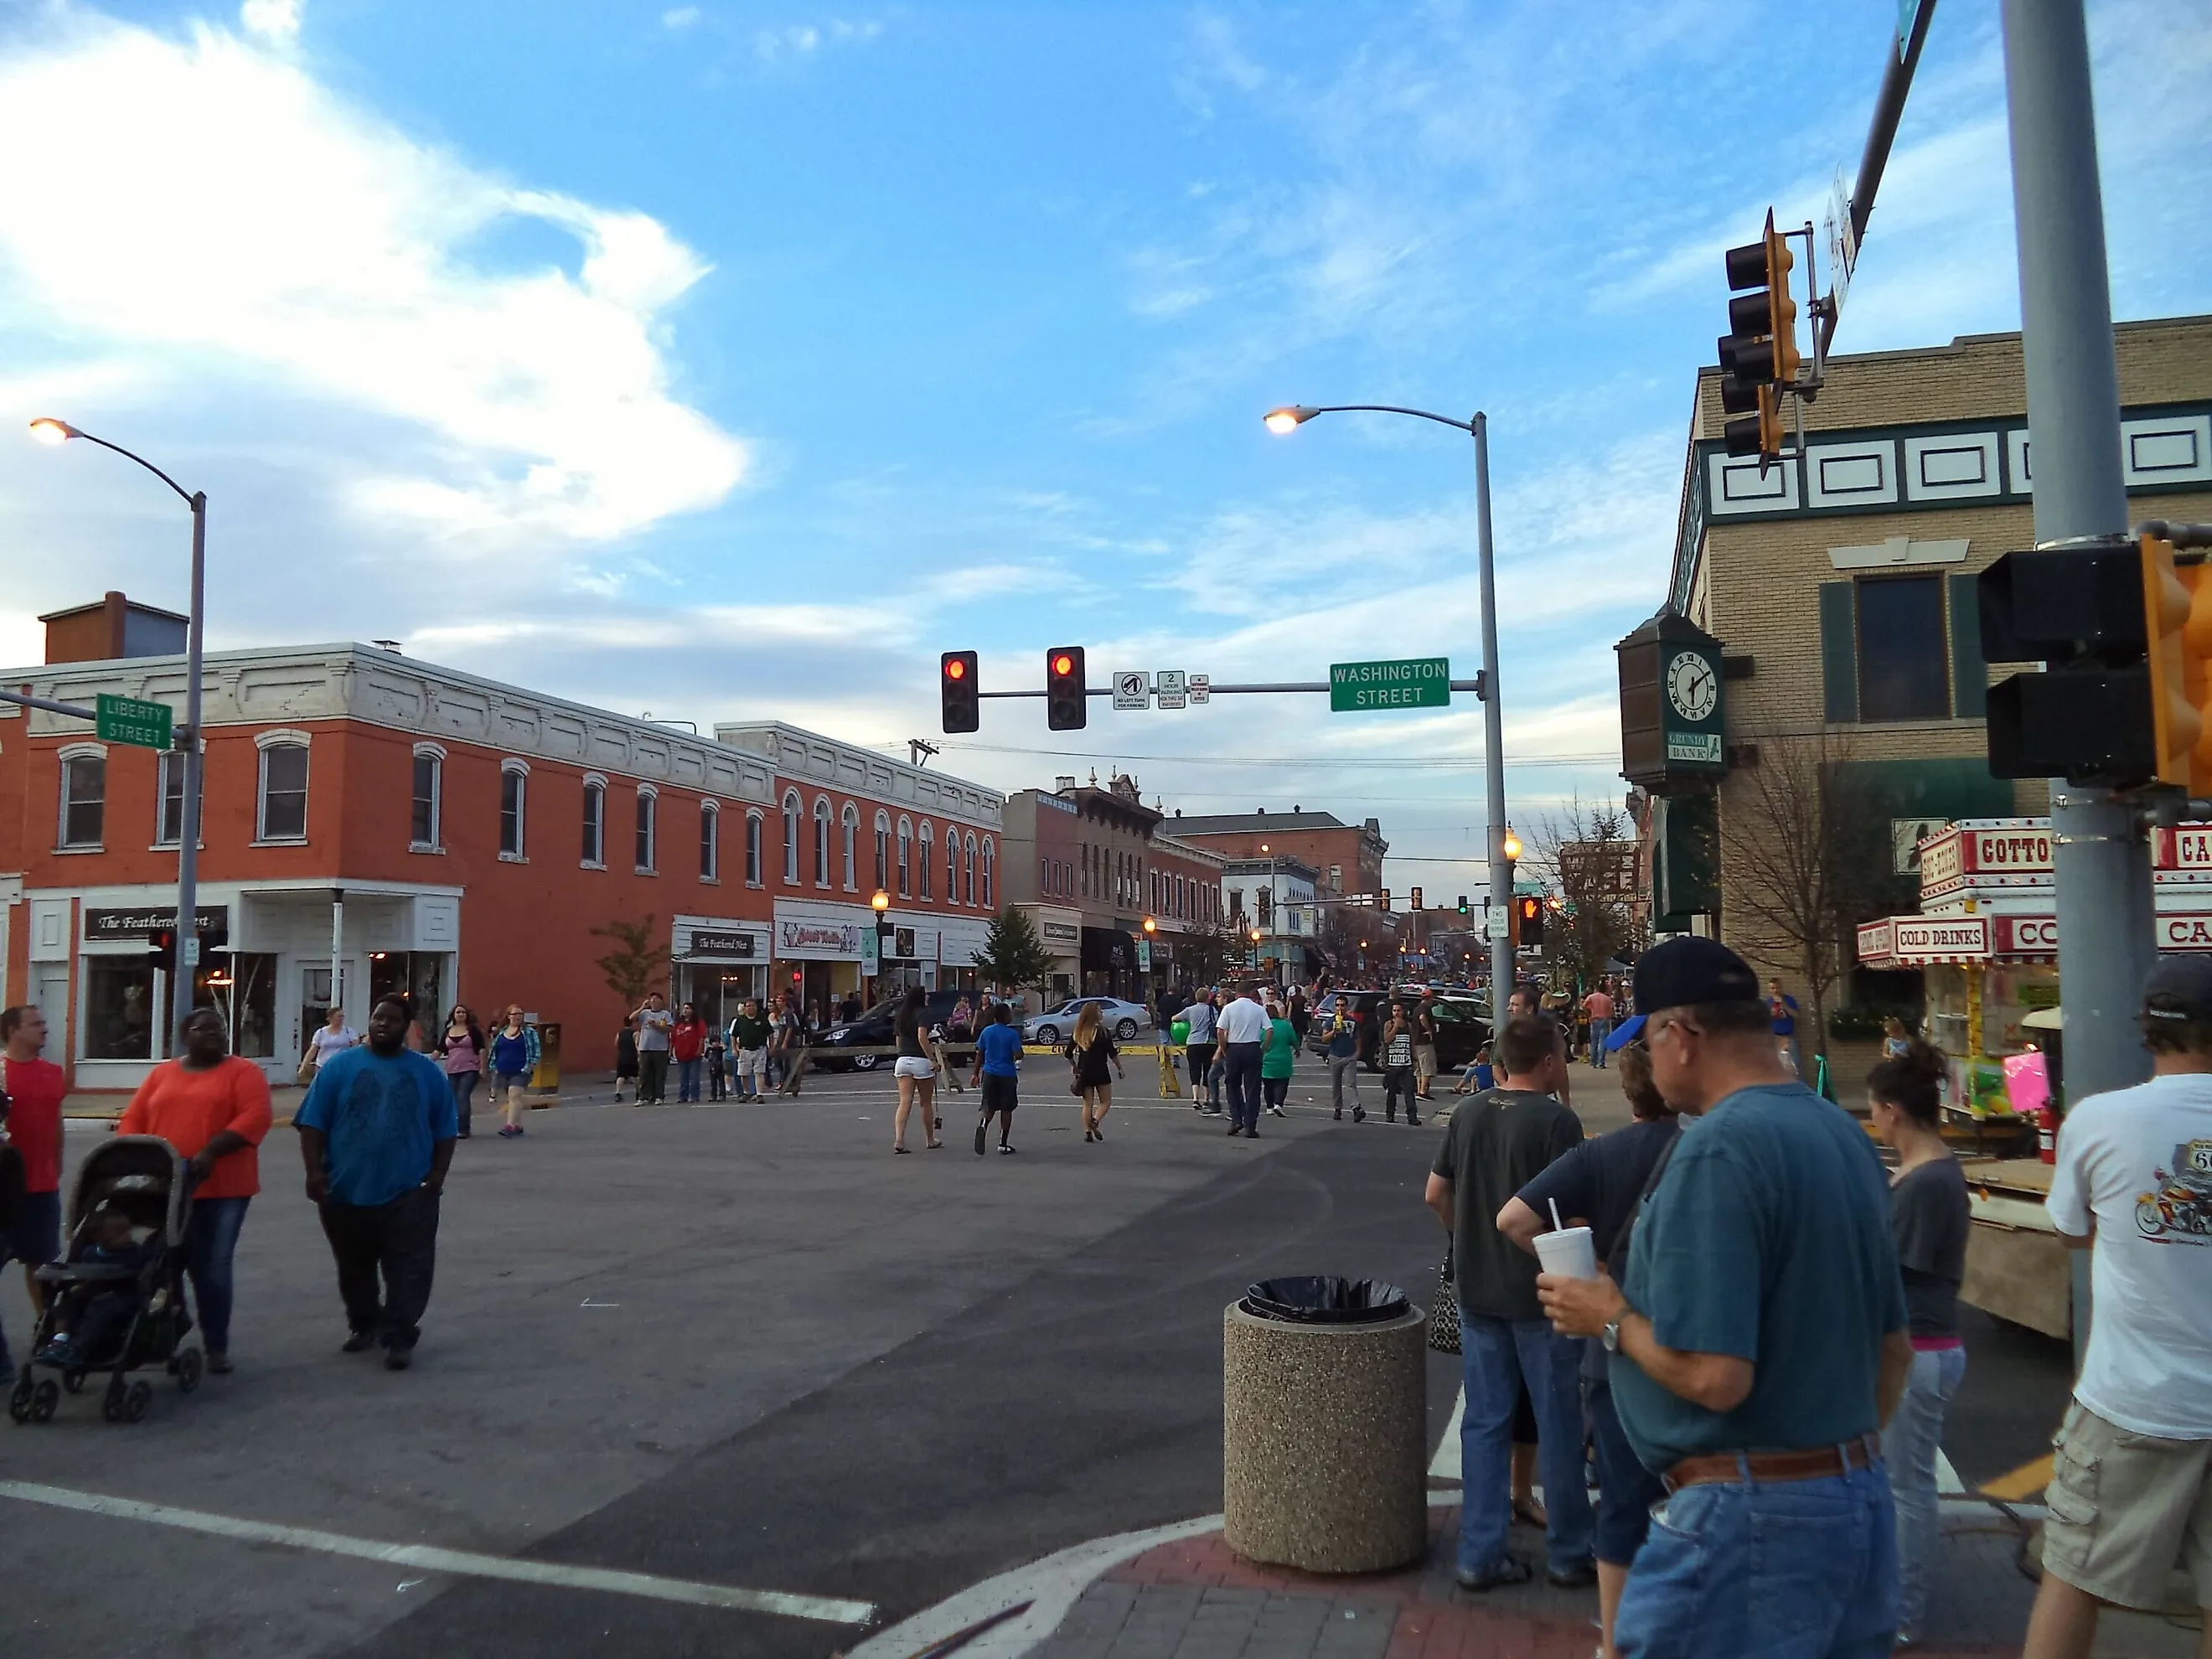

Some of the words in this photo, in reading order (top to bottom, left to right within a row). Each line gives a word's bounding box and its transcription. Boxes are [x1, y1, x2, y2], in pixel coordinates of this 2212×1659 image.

[1167, 674, 1175, 683] 2
[1334, 663, 1446, 683] WASHINGTON
[1356, 687, 1424, 705] STREET
[106, 700, 163, 721] LIBERTY
[110, 722, 160, 743] STREET
[1669, 734, 1706, 746] GRUNDY
[1672, 747, 1706, 758] BANK
[1982, 838, 2054, 864] COTTO
[99, 915, 119, 929] The
[1899, 930, 1930, 946] COLD
[1932, 928, 1982, 945] DRINKS
